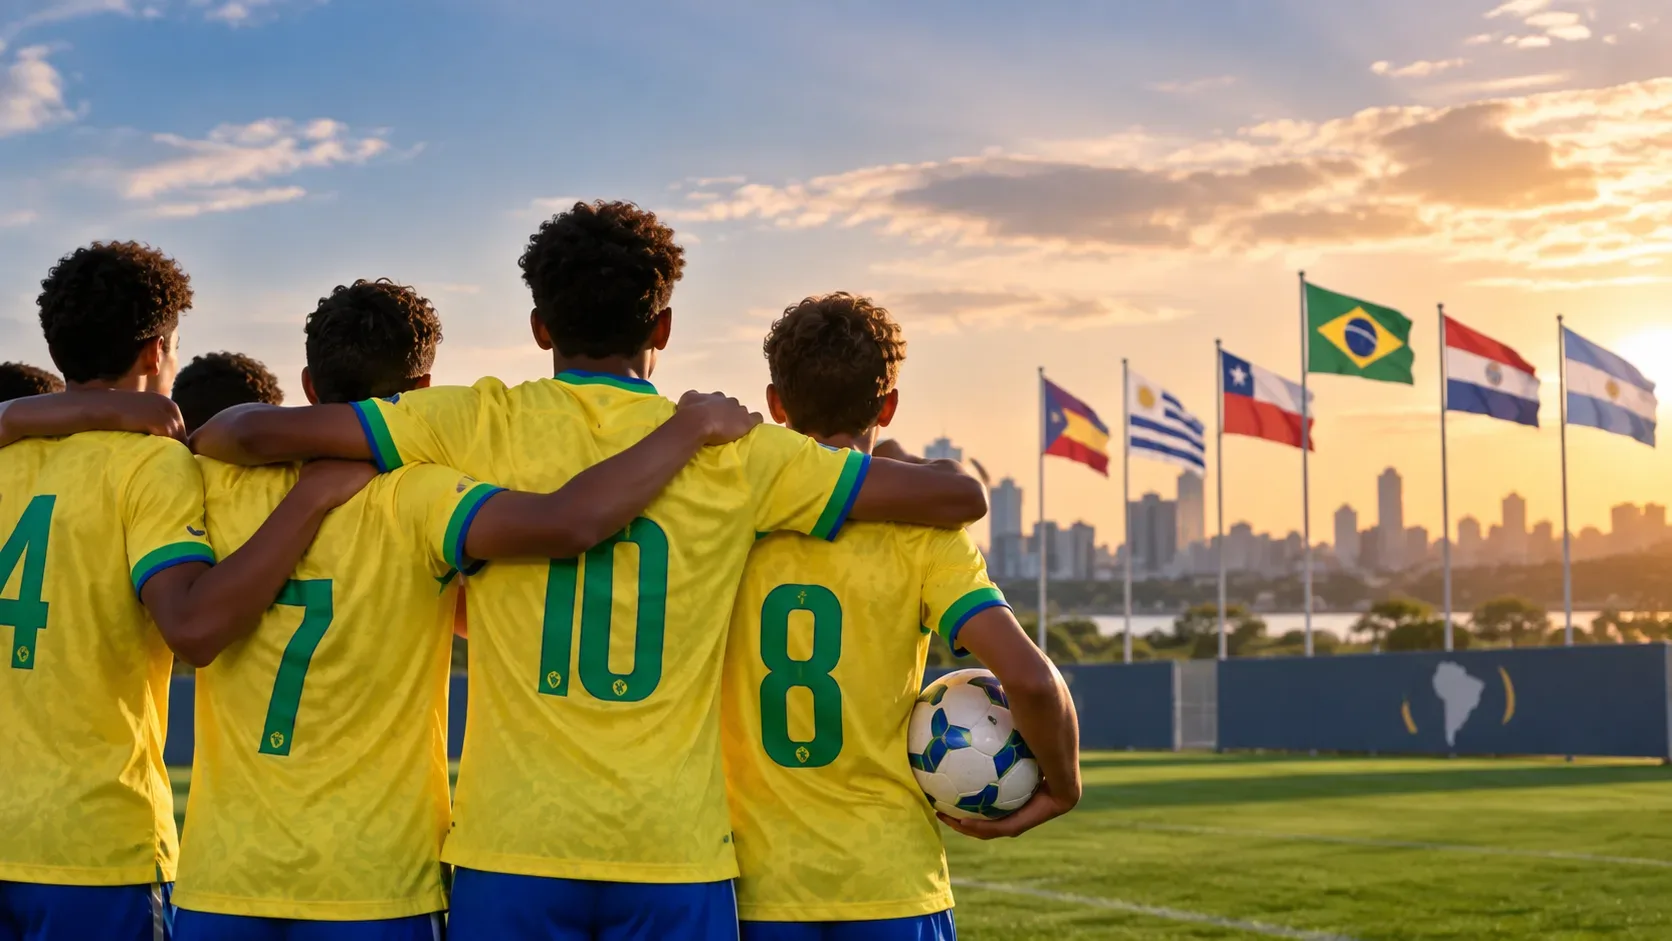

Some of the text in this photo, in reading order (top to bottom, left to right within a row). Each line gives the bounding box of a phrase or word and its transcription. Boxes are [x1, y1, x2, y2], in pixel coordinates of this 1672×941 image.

[0, 494, 56, 669] 4
[258, 579, 333, 755] 7
[539, 517, 669, 701] 10
[760, 584, 842, 767] 8
